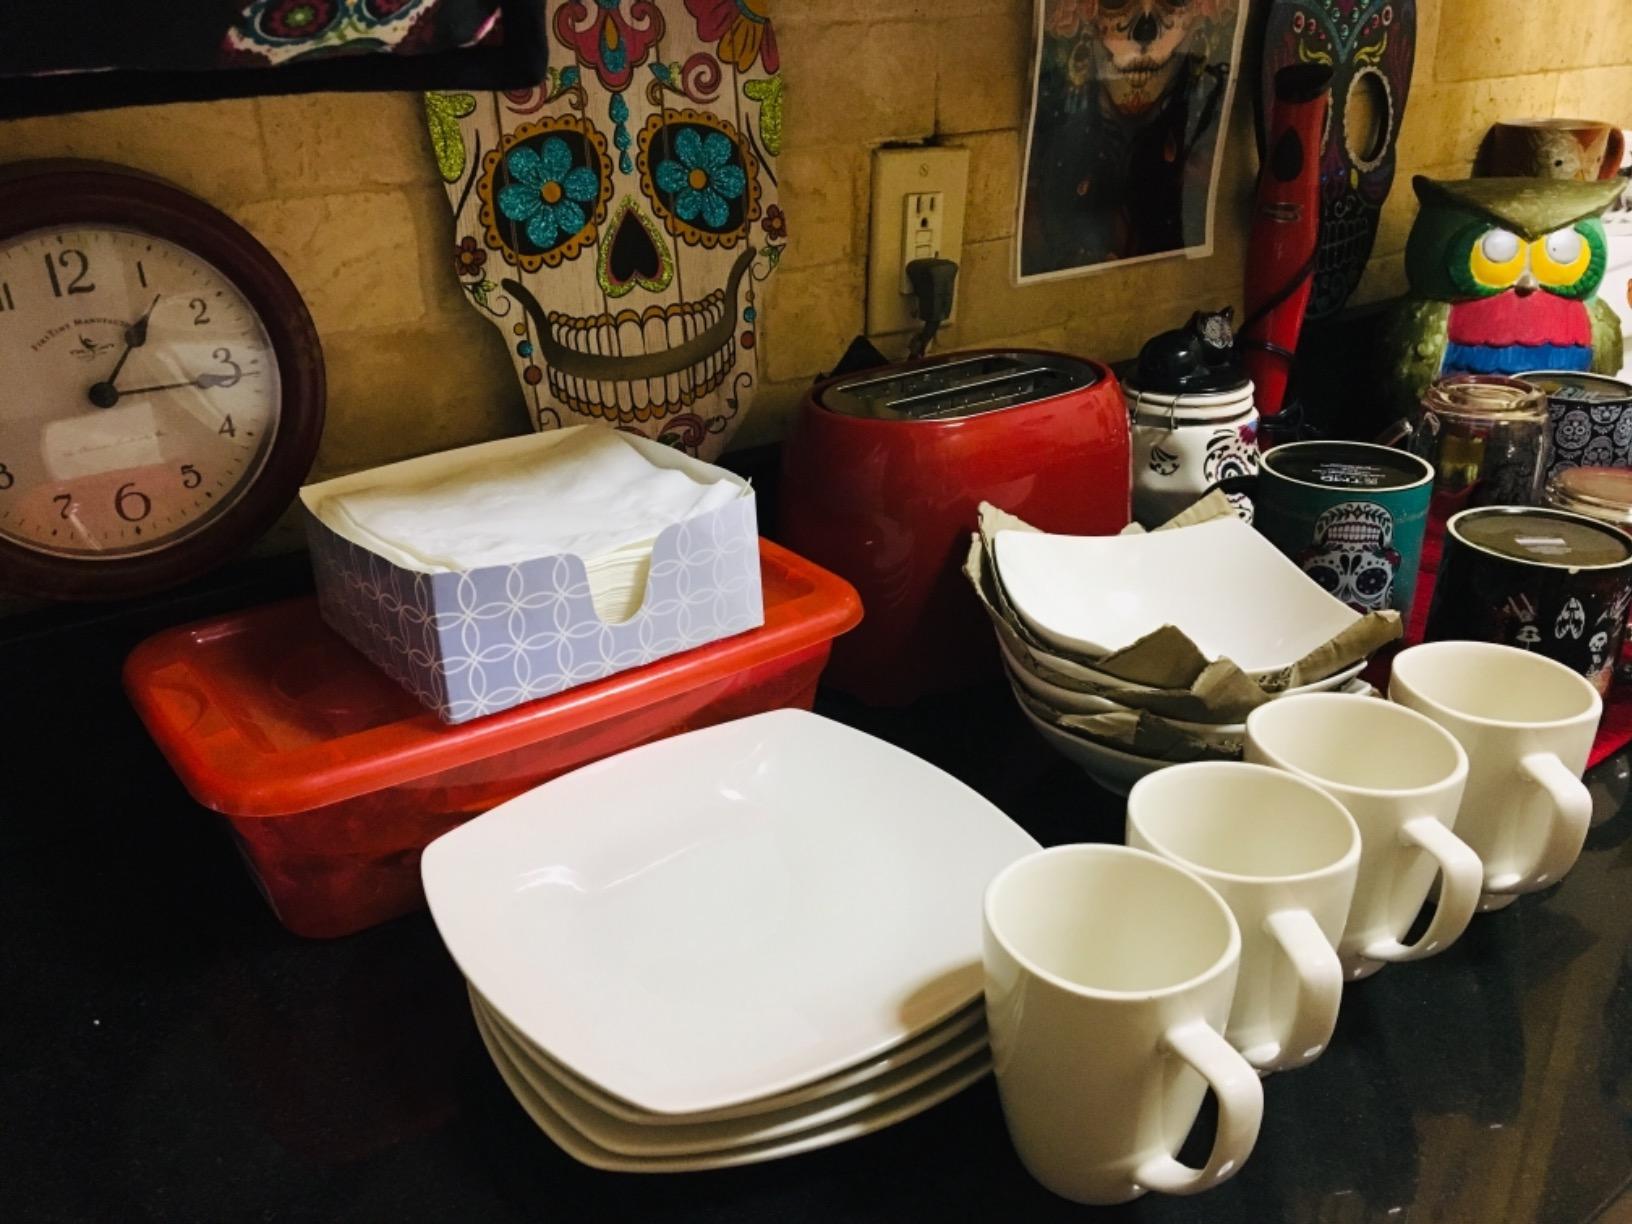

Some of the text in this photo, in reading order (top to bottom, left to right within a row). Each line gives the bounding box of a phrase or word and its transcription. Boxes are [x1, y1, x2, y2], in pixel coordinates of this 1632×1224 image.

[44, 250, 96, 298] 12
[137, 261, 148, 288] 1
[189, 298, 211, 326] 2
[211, 348, 243, 388] 3
[218, 414, 236, 438] 4
[180, 464, 203, 489] 5
[53, 494, 74, 520] 7
[114, 482, 152, 522] 6
